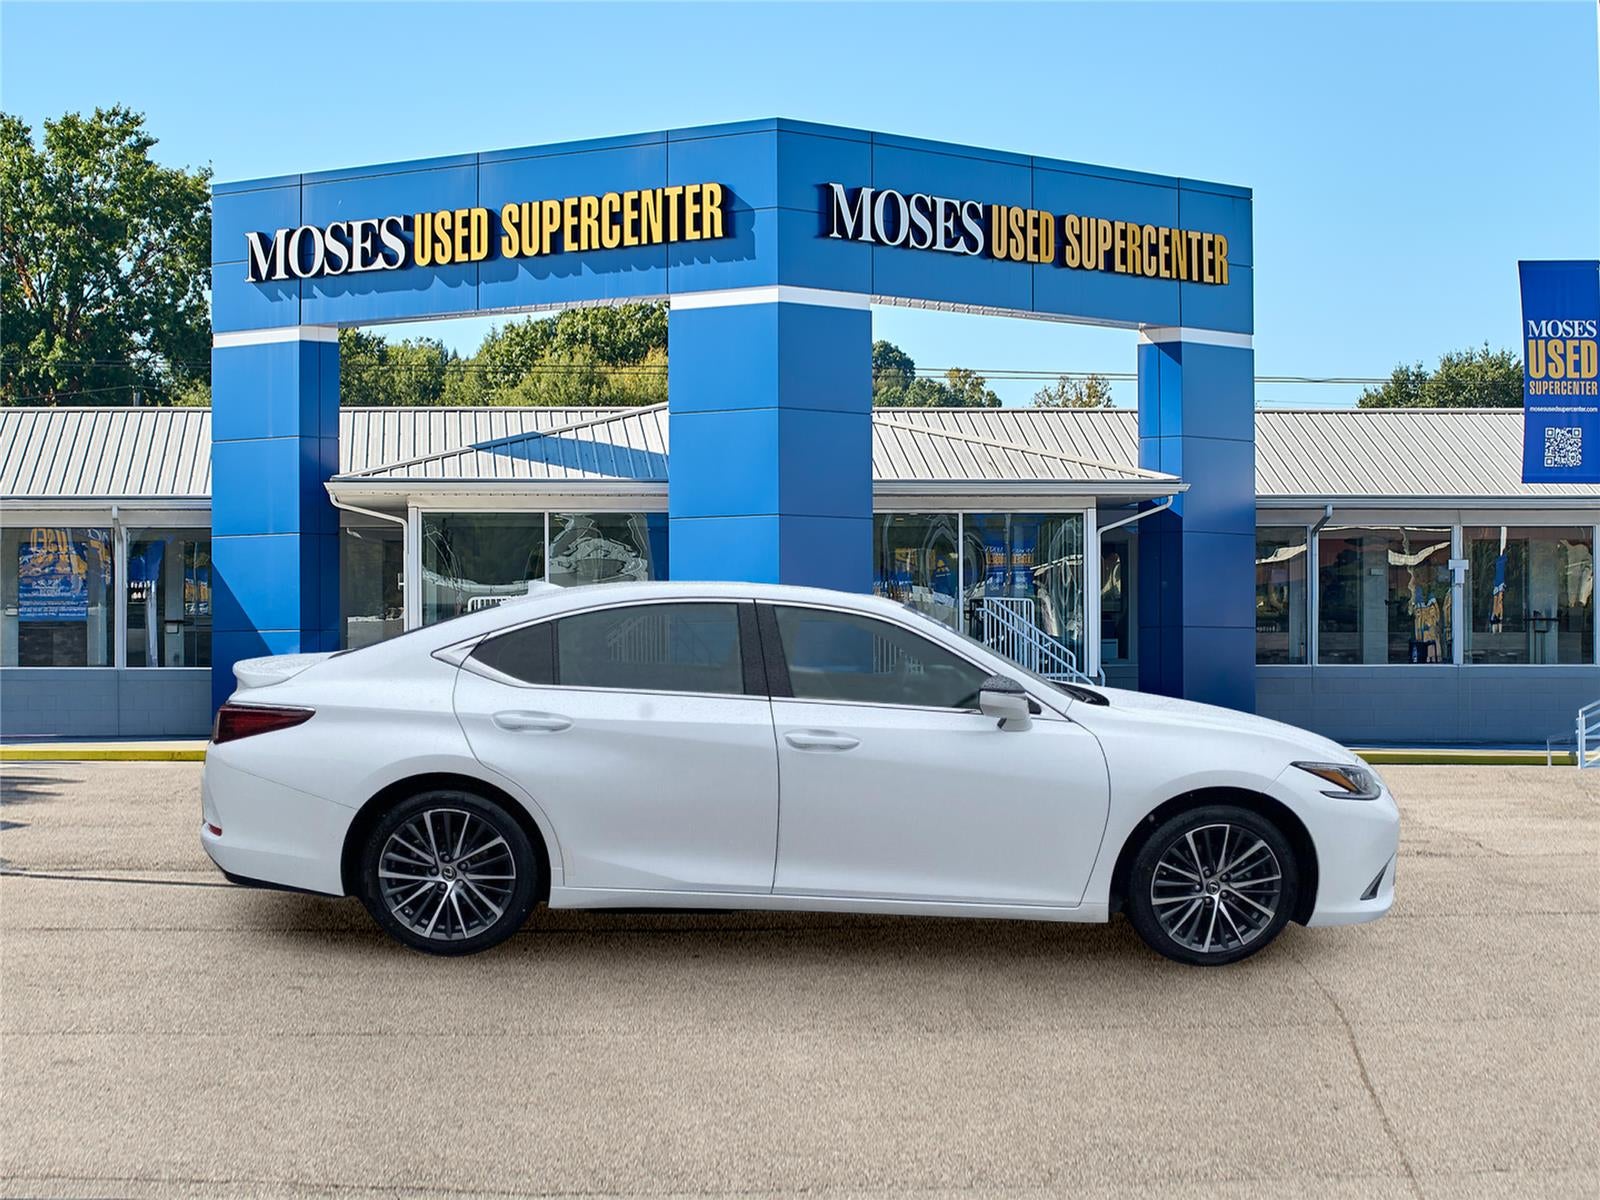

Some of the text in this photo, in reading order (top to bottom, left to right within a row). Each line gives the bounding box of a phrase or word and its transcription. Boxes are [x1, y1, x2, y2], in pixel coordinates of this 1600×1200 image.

[244, 182, 723, 282] MOSES USED SUPERCENTER
[828, 182, 1230, 285] MOSES USED SUPERCENTER
[1528, 319, 1597, 338] MOSES
[1529, 340, 1598, 379] USED
[1529, 381, 1598, 395] SUPERCENTER
